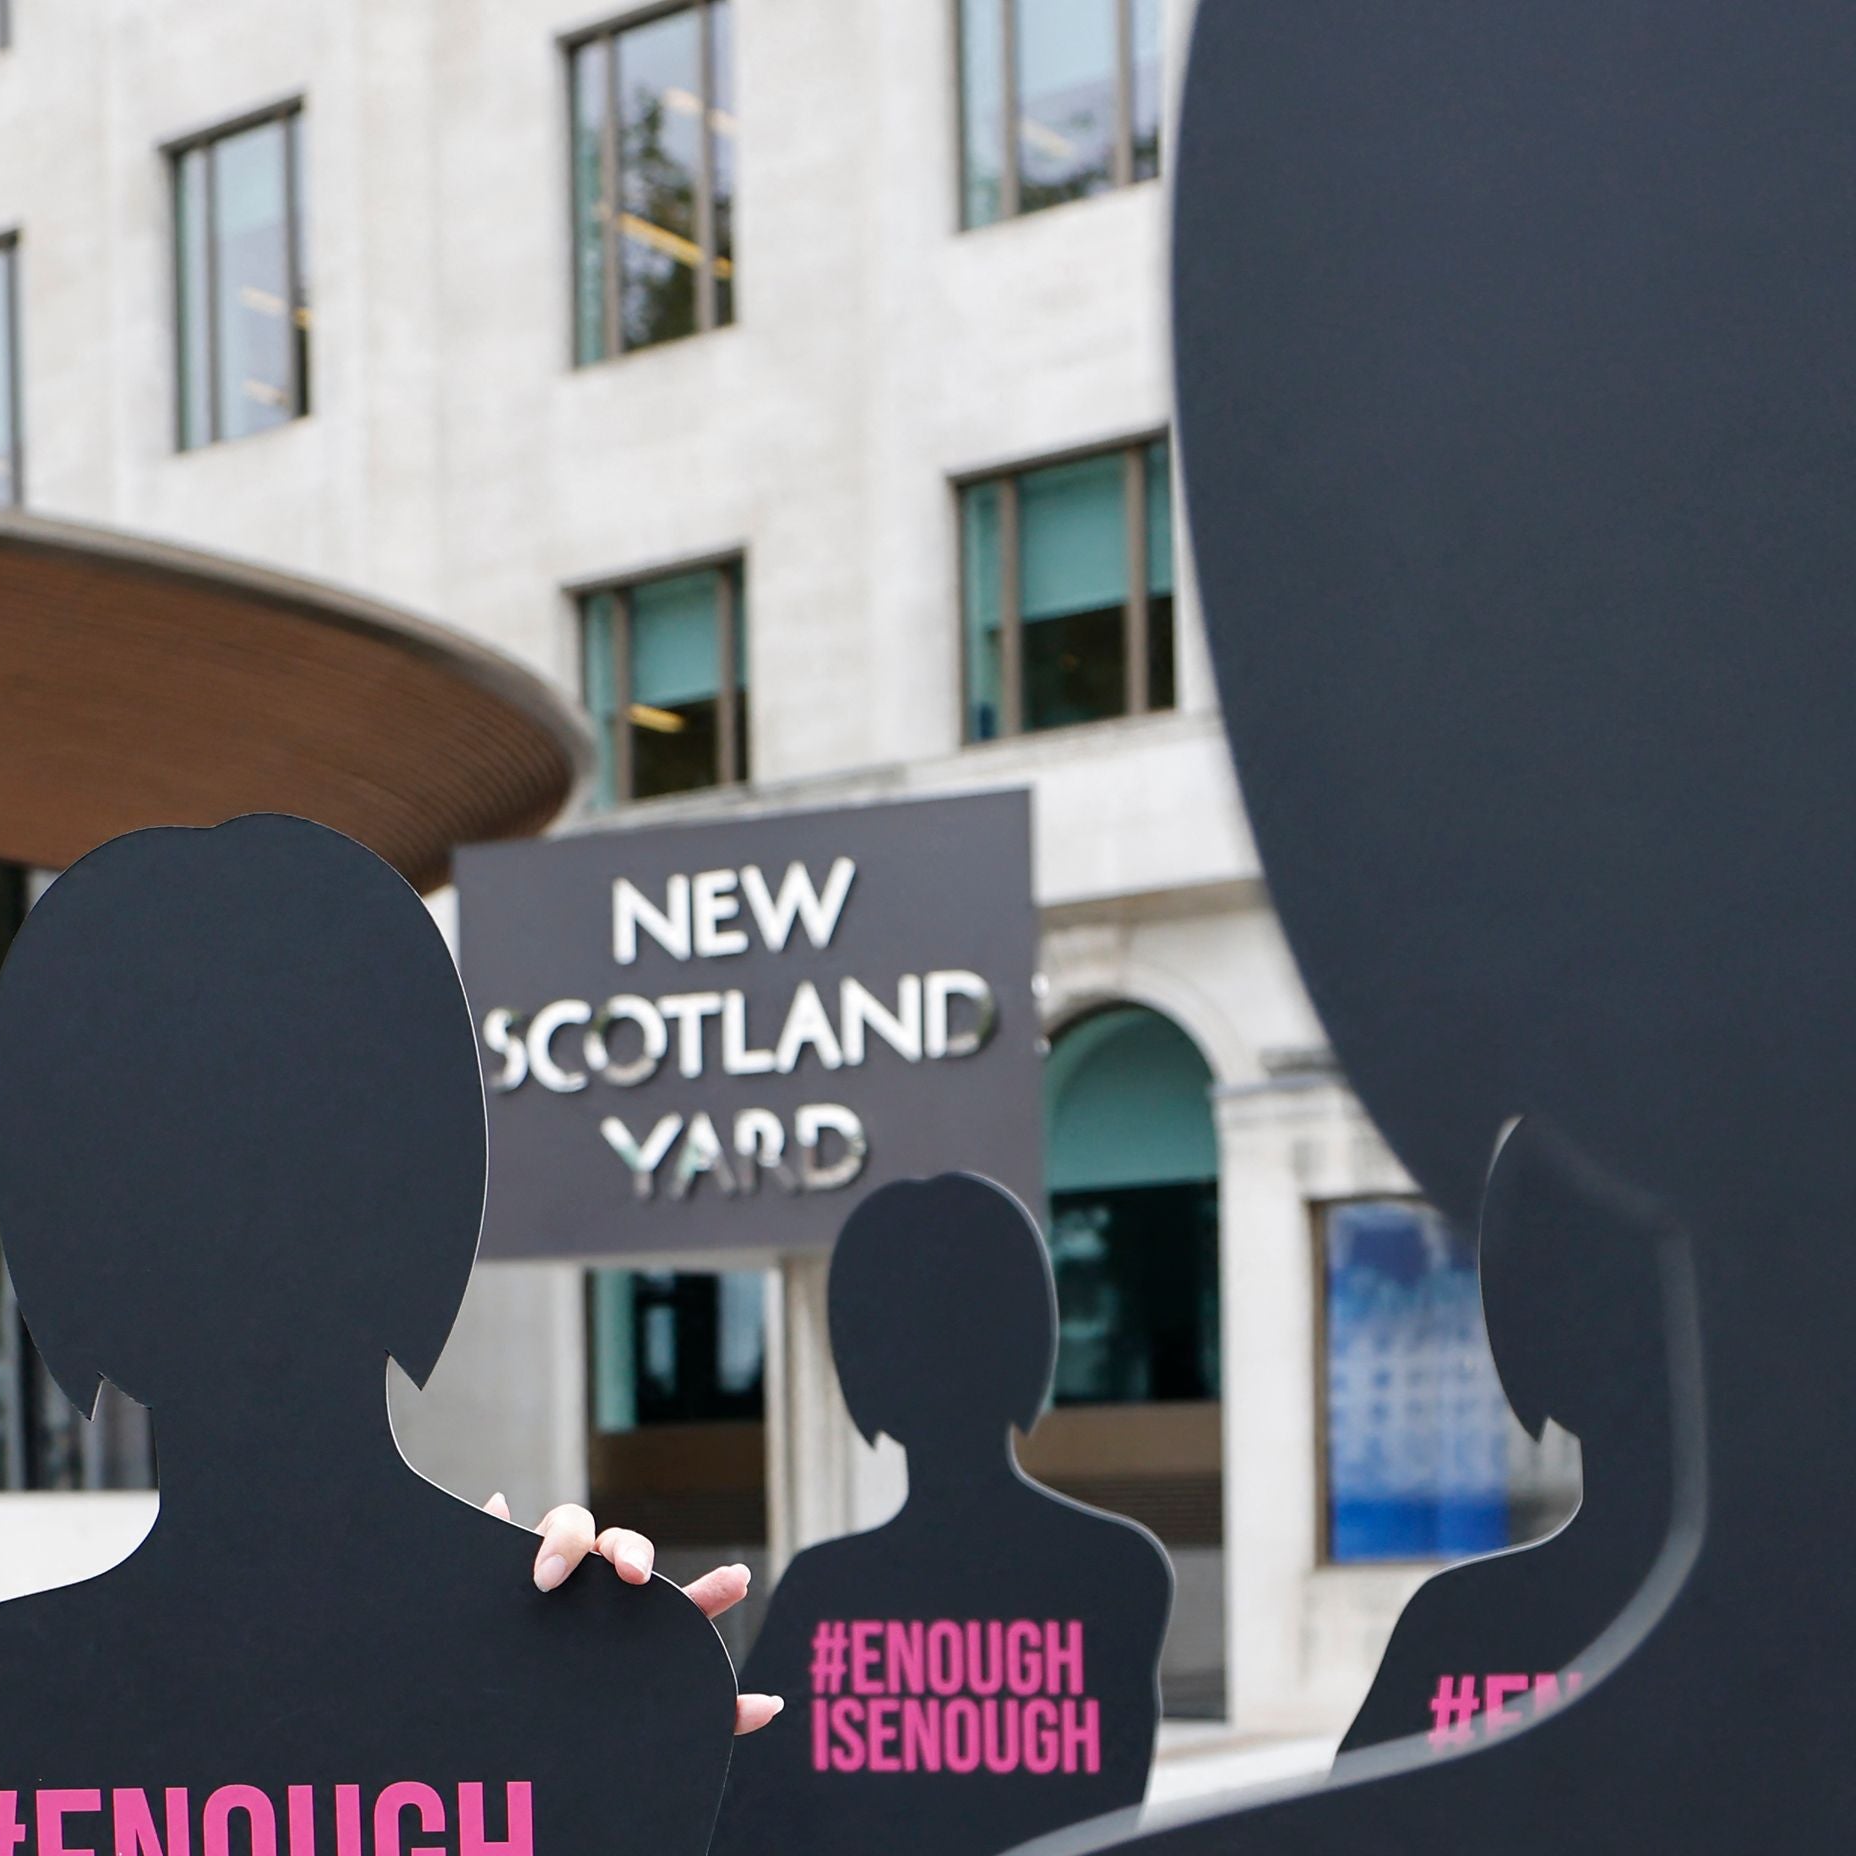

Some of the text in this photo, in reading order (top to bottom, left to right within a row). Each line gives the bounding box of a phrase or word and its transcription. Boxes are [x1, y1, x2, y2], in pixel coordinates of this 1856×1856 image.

[611, 856, 857, 966] NEW
[482, 968, 998, 1094] SCOTLAND
[600, 1103, 867, 1199] YARD
[809, 1618, 1084, 1696] #ENOUGH
[811, 1696, 1101, 1775] ISENOUGH
